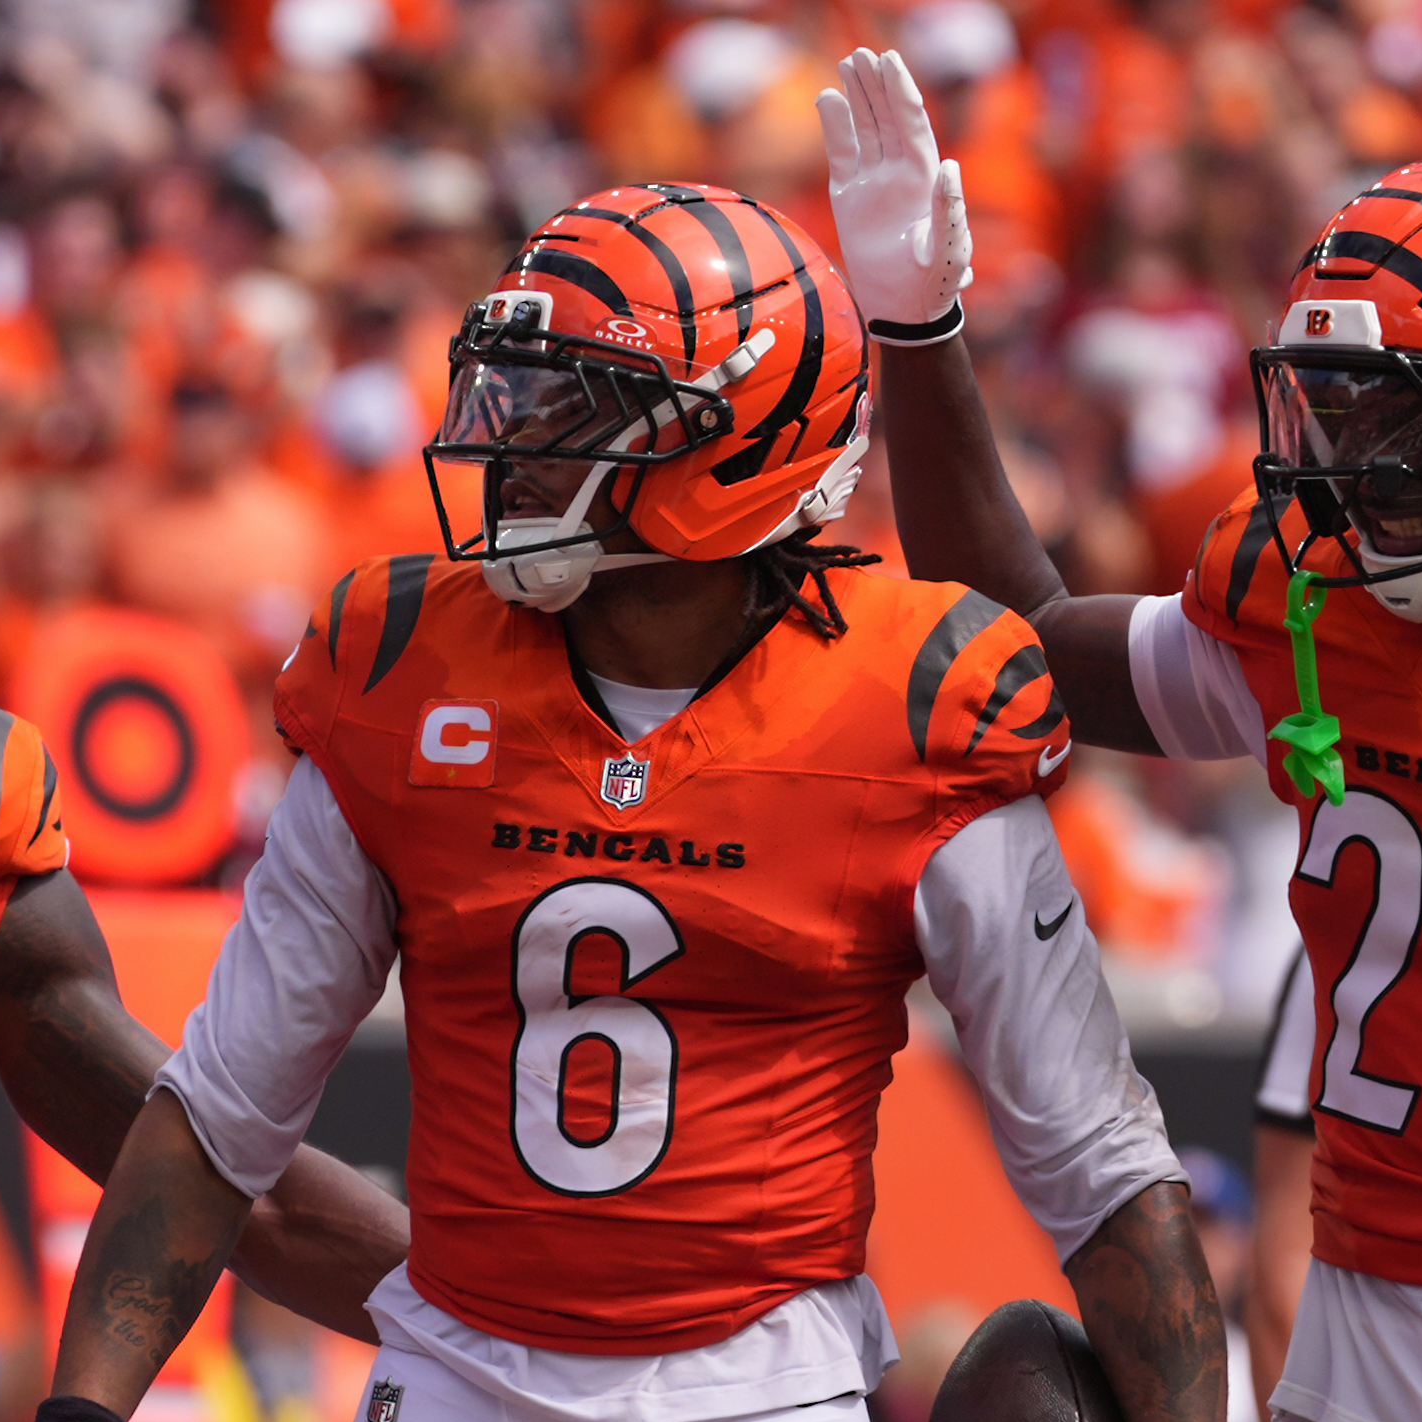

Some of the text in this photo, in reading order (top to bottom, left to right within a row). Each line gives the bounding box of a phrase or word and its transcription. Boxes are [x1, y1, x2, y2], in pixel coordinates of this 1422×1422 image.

[594, 330, 653, 350] OAKLEY
[420, 706, 491, 765] C
[608, 778, 638, 799] NFL
[492, 823, 746, 868] BENGALS
[510, 875, 686, 1198] 6
[369, 1401, 393, 1422] NFL
